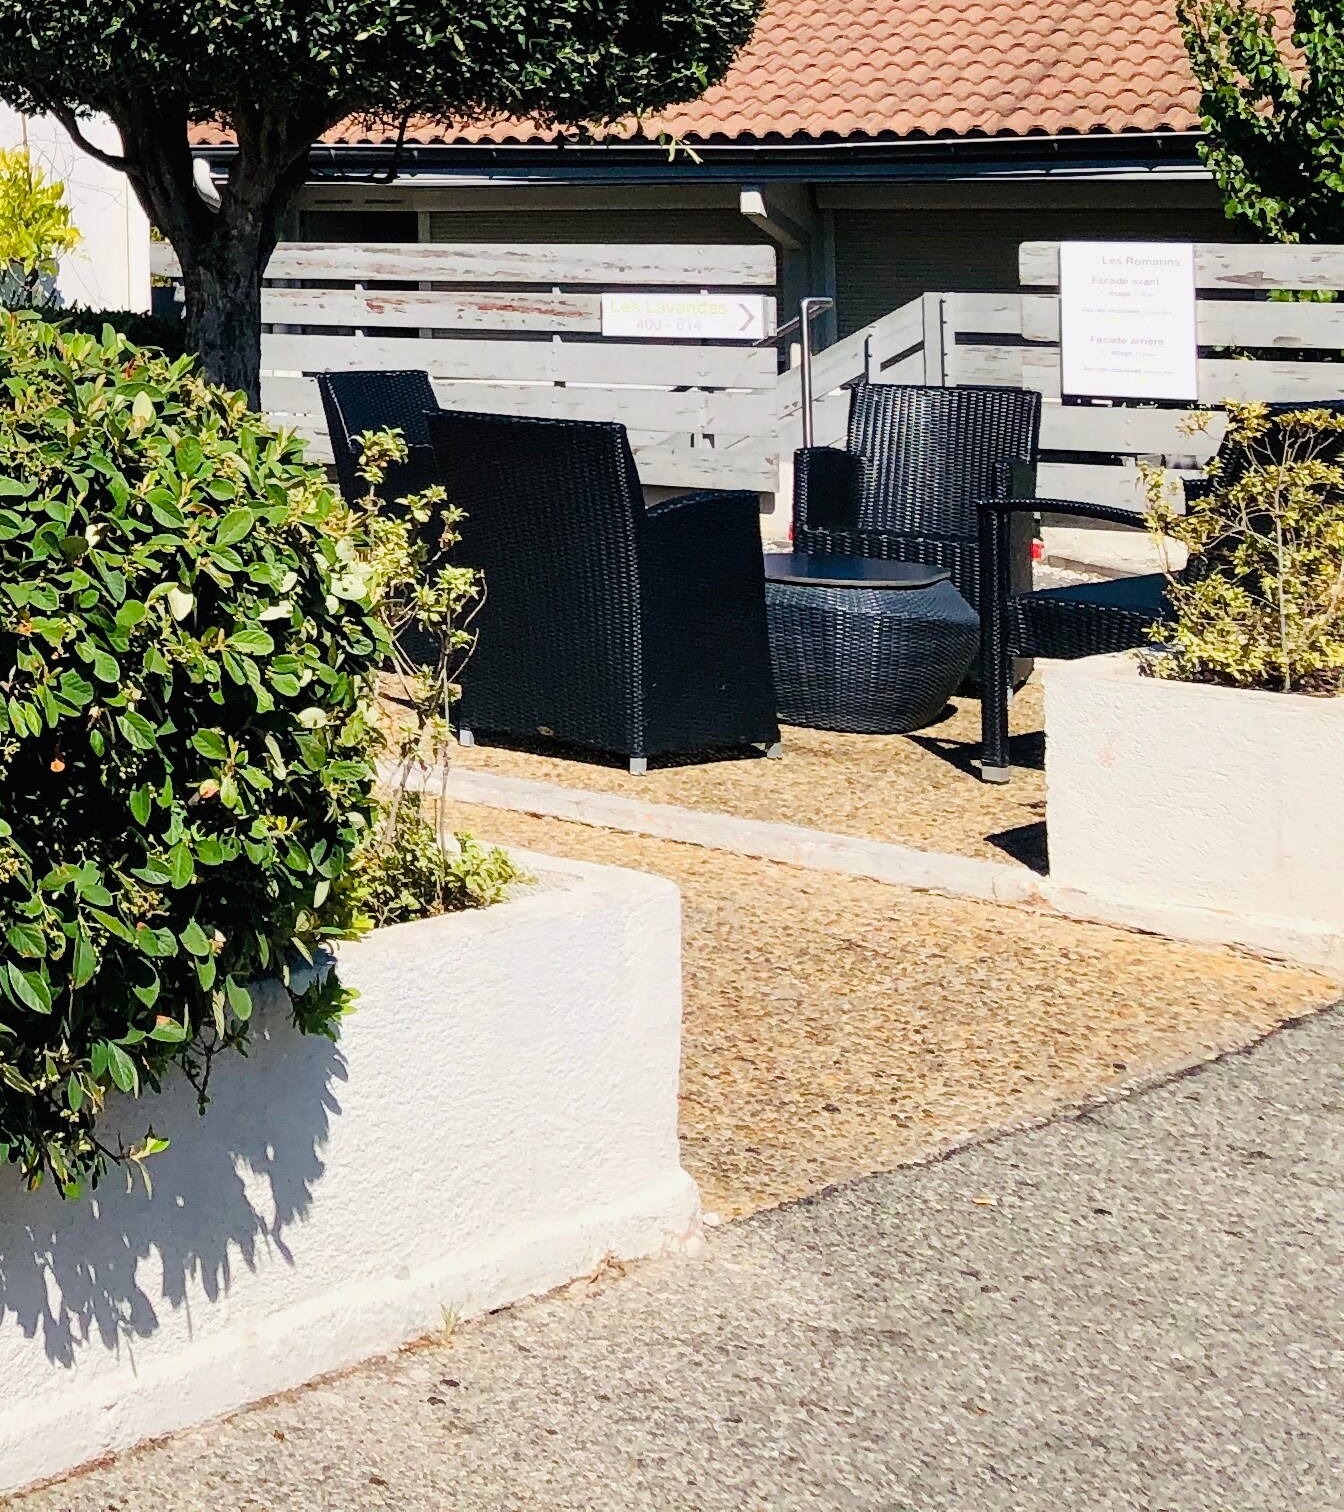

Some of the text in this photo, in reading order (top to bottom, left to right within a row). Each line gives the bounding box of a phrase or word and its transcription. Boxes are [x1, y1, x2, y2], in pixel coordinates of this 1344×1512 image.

[1102, 256, 1181, 268] Les Romarins
[1131, 278, 1160, 287] avant
[610, 299, 729, 315] Les Lavandes
[636, 318, 662, 331] 400
[675, 318, 702, 331] 614
